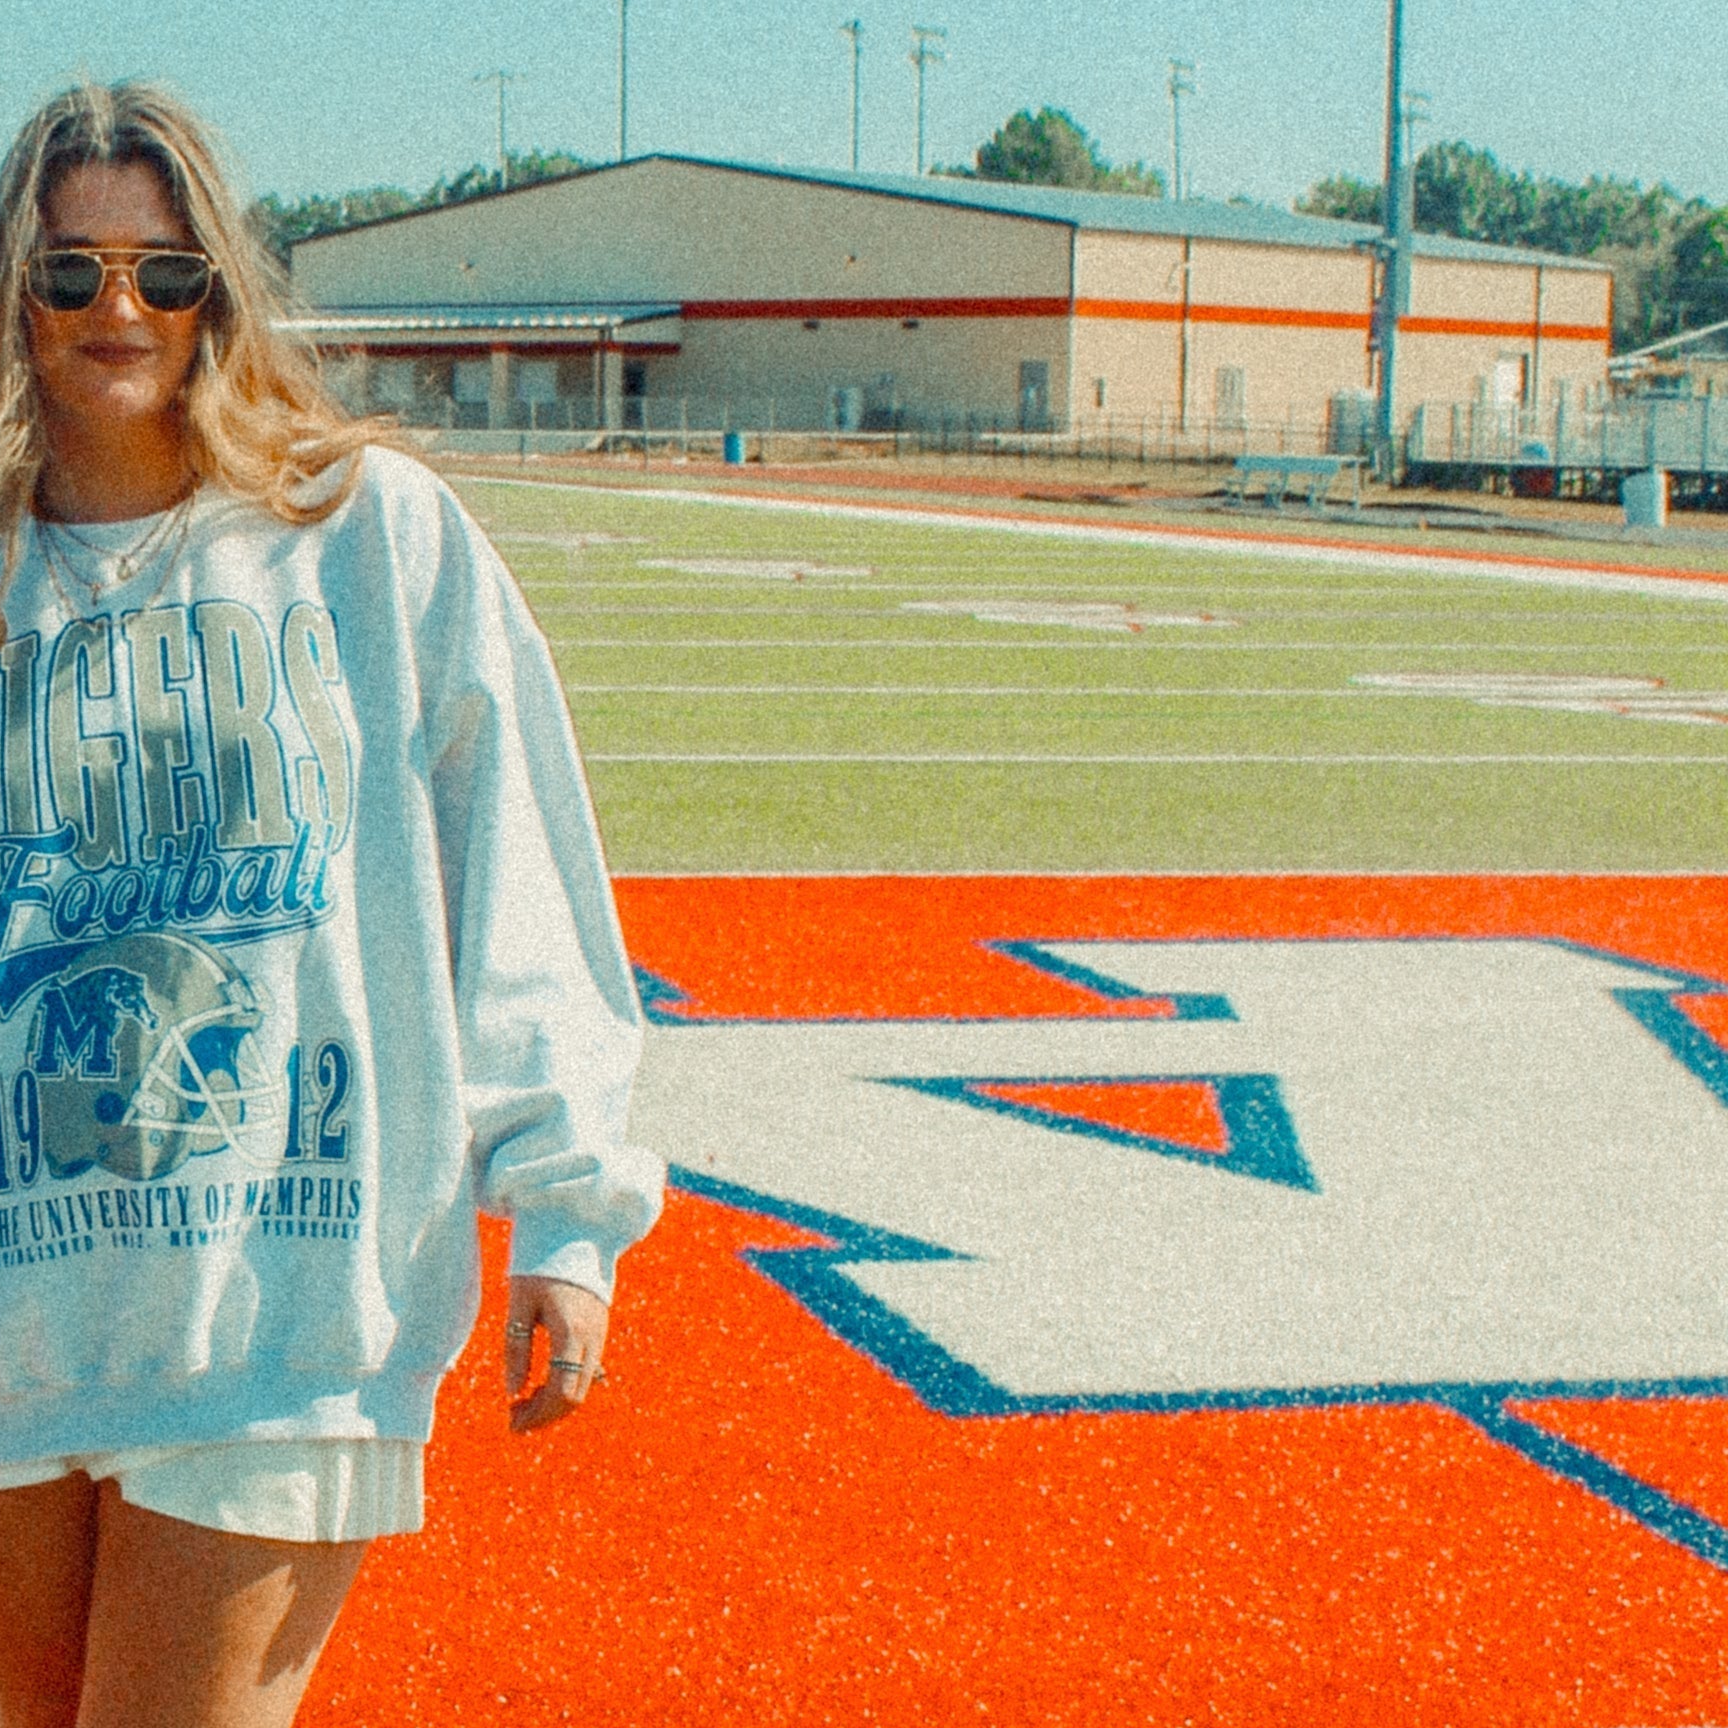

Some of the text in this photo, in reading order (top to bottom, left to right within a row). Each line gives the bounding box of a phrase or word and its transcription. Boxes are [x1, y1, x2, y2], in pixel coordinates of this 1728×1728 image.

[27, 985, 120, 1081] M
[29, 1186, 189, 1241] UNIVERSITY
[205, 1183, 234, 1223] OF
[244, 1177, 362, 1219] MEMPHIS
